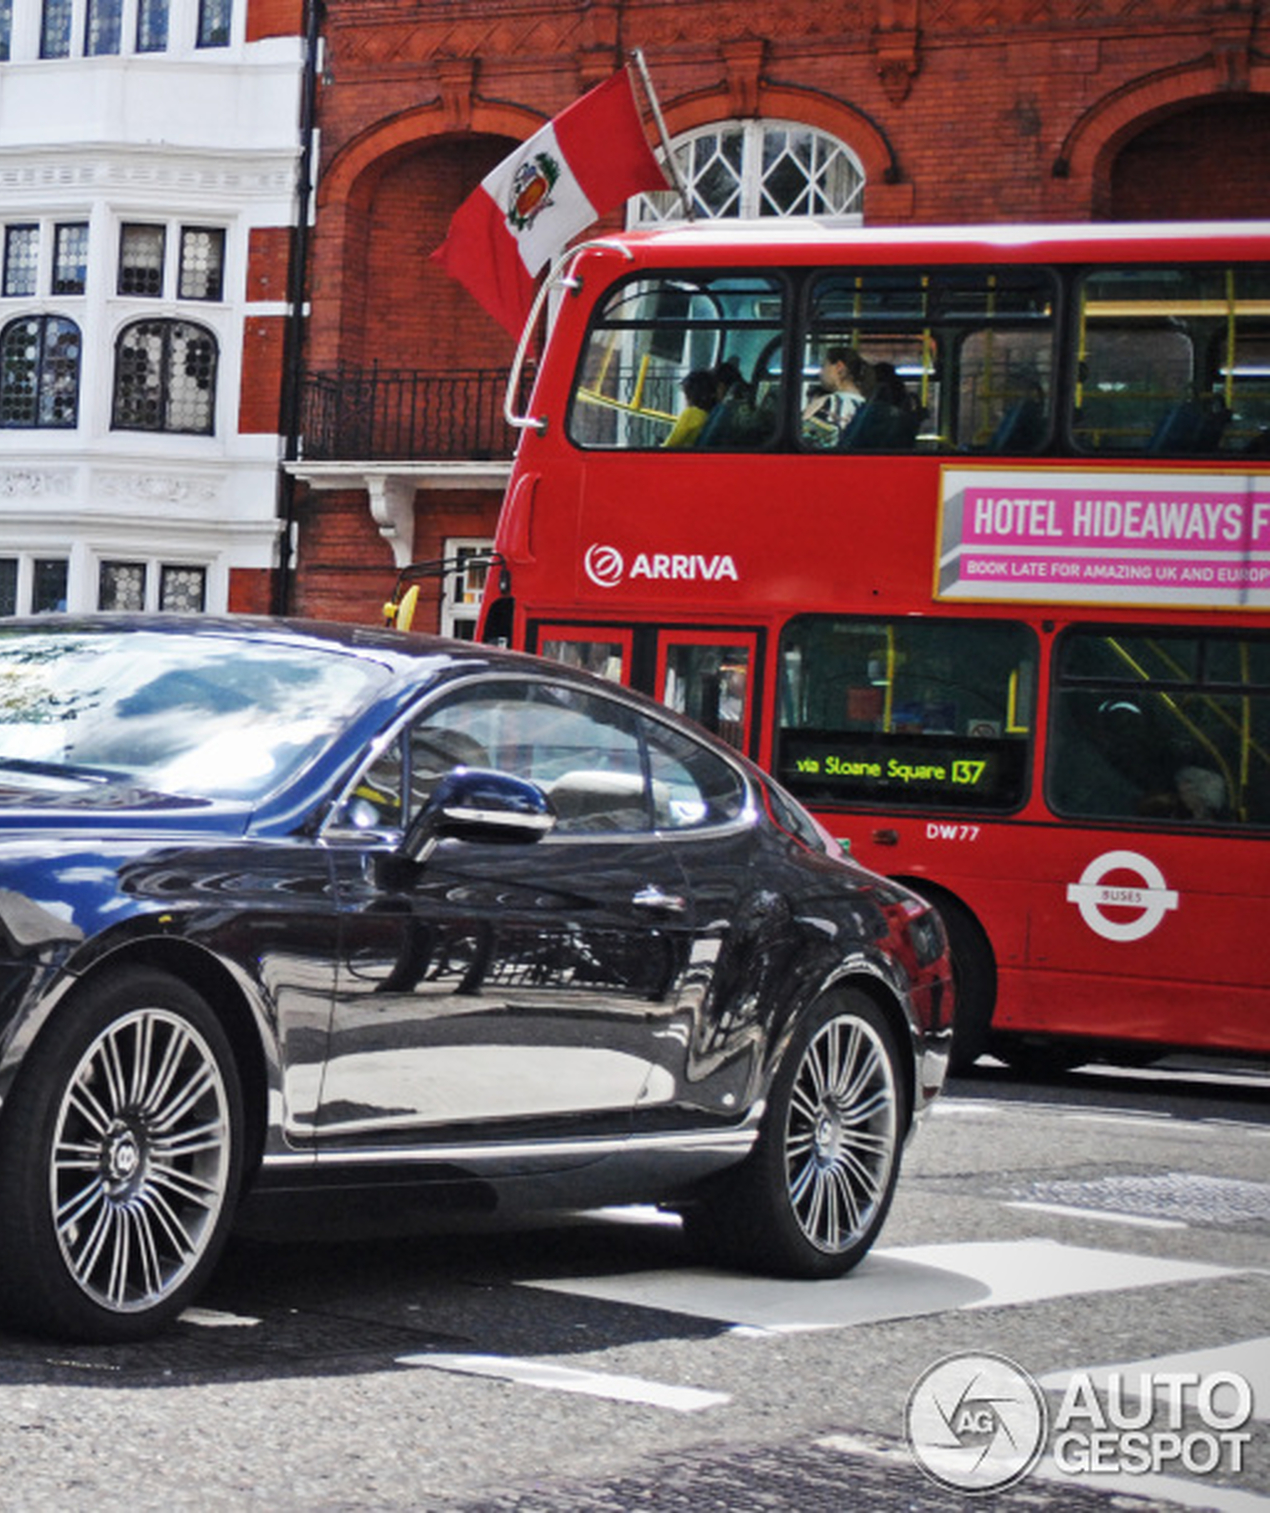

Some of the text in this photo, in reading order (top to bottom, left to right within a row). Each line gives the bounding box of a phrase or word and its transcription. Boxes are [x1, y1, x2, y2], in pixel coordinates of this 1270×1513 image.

[974, 498, 1062, 536] HOTEL
[1073, 500, 1243, 540] HIDEAWAYS
[630, 553, 738, 581] ARRIVA
[966, 560, 1008, 575] BOOK
[1011, 562, 1047, 576] LATE
[1051, 563, 1080, 577] FOR
[1083, 564, 1152, 579] AMAZING
[1155, 567, 1177, 580] UK
[1181, 567, 1214, 581] AND
[796, 756, 985, 784] via Sloane Square 137
[1101, 890, 1142, 903] BUSES
